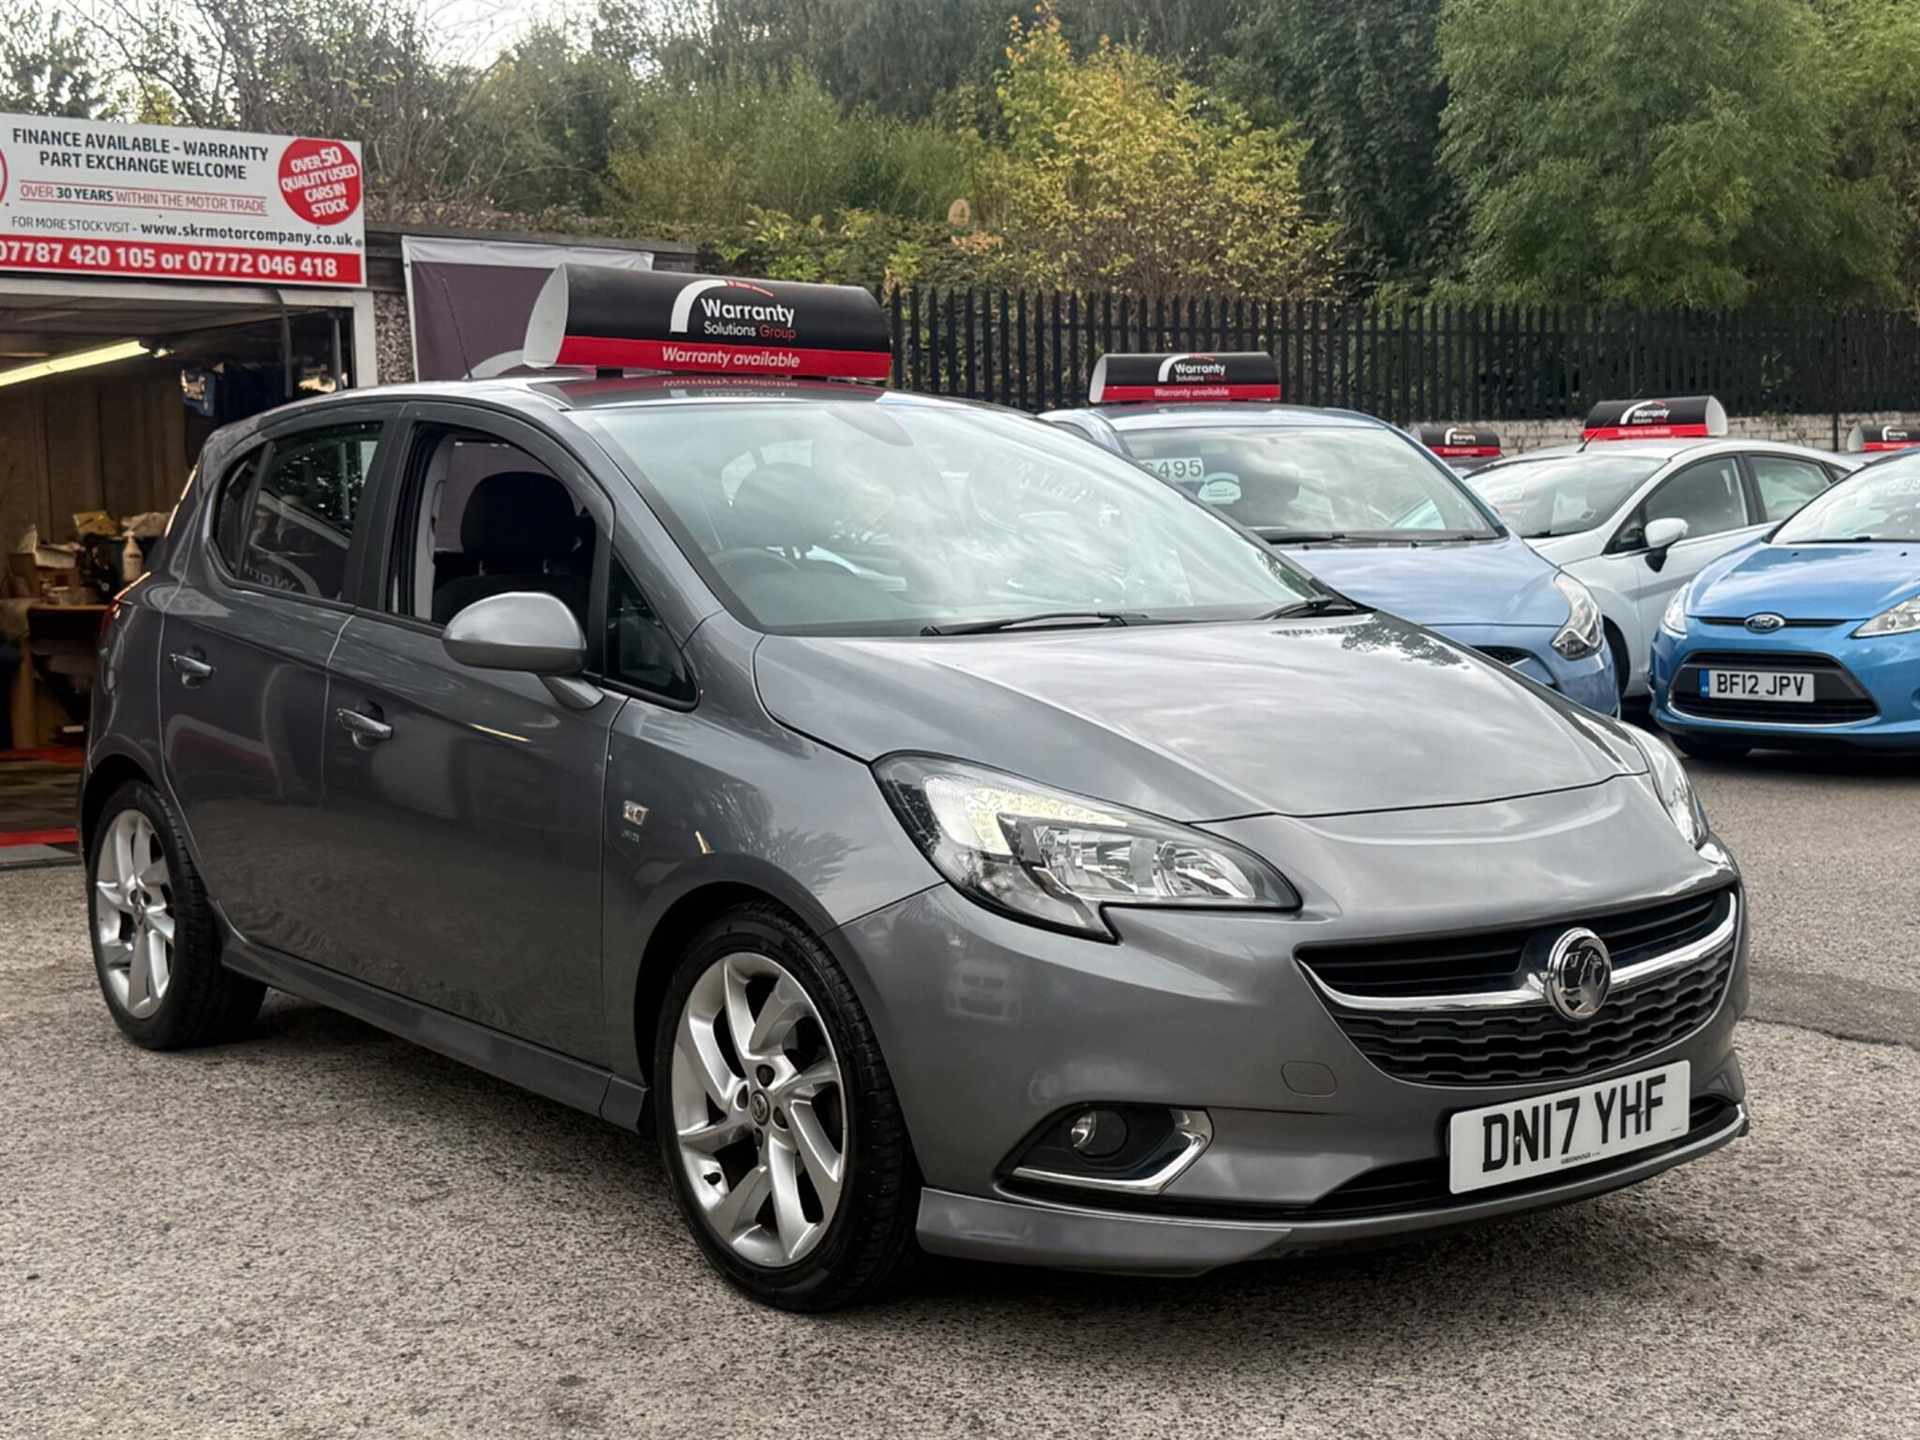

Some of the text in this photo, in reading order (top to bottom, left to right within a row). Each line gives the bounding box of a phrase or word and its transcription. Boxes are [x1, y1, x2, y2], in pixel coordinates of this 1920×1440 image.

[13, 128, 82, 147] FINANCE
[85, 133, 171, 154] AVAILABLE
[183, 141, 268, 161] WARRANTY
[39, 151, 247, 180] PART EXCHANGE WELCOME
[290, 146, 343, 173] OVER 50
[281, 163, 358, 193] QUALITY USED
[304, 181, 347, 203] CARS IN
[20, 184, 267, 212] OVER 30 YEARS WITHIN THE MOTOR TRADE
[310, 197, 350, 218] STOCK
[12, 216, 34, 228] FOR
[35, 217, 67, 230] MORE
[68, 219, 103, 232] STOCK
[104, 221, 130, 233] VISIT
[141, 223, 353, 246] www.skrmotorcompany.co.uk
[69, 244, 111, 266] 420
[116, 246, 156, 269] 105
[161, 253, 184, 270] or
[188, 250, 254, 273] 07772
[258, 254, 297, 276] 046
[300, 256, 338, 278] 418
[700, 297, 795, 328] Warranty
[704, 320, 797, 341] Solutions Group
[662, 346, 801, 368] Warranty available
[1174, 363, 1226, 376] Warranty
[1716, 673, 1805, 697] BF12 JPV
[1482, 1073, 1667, 1173] DN17 YHF
